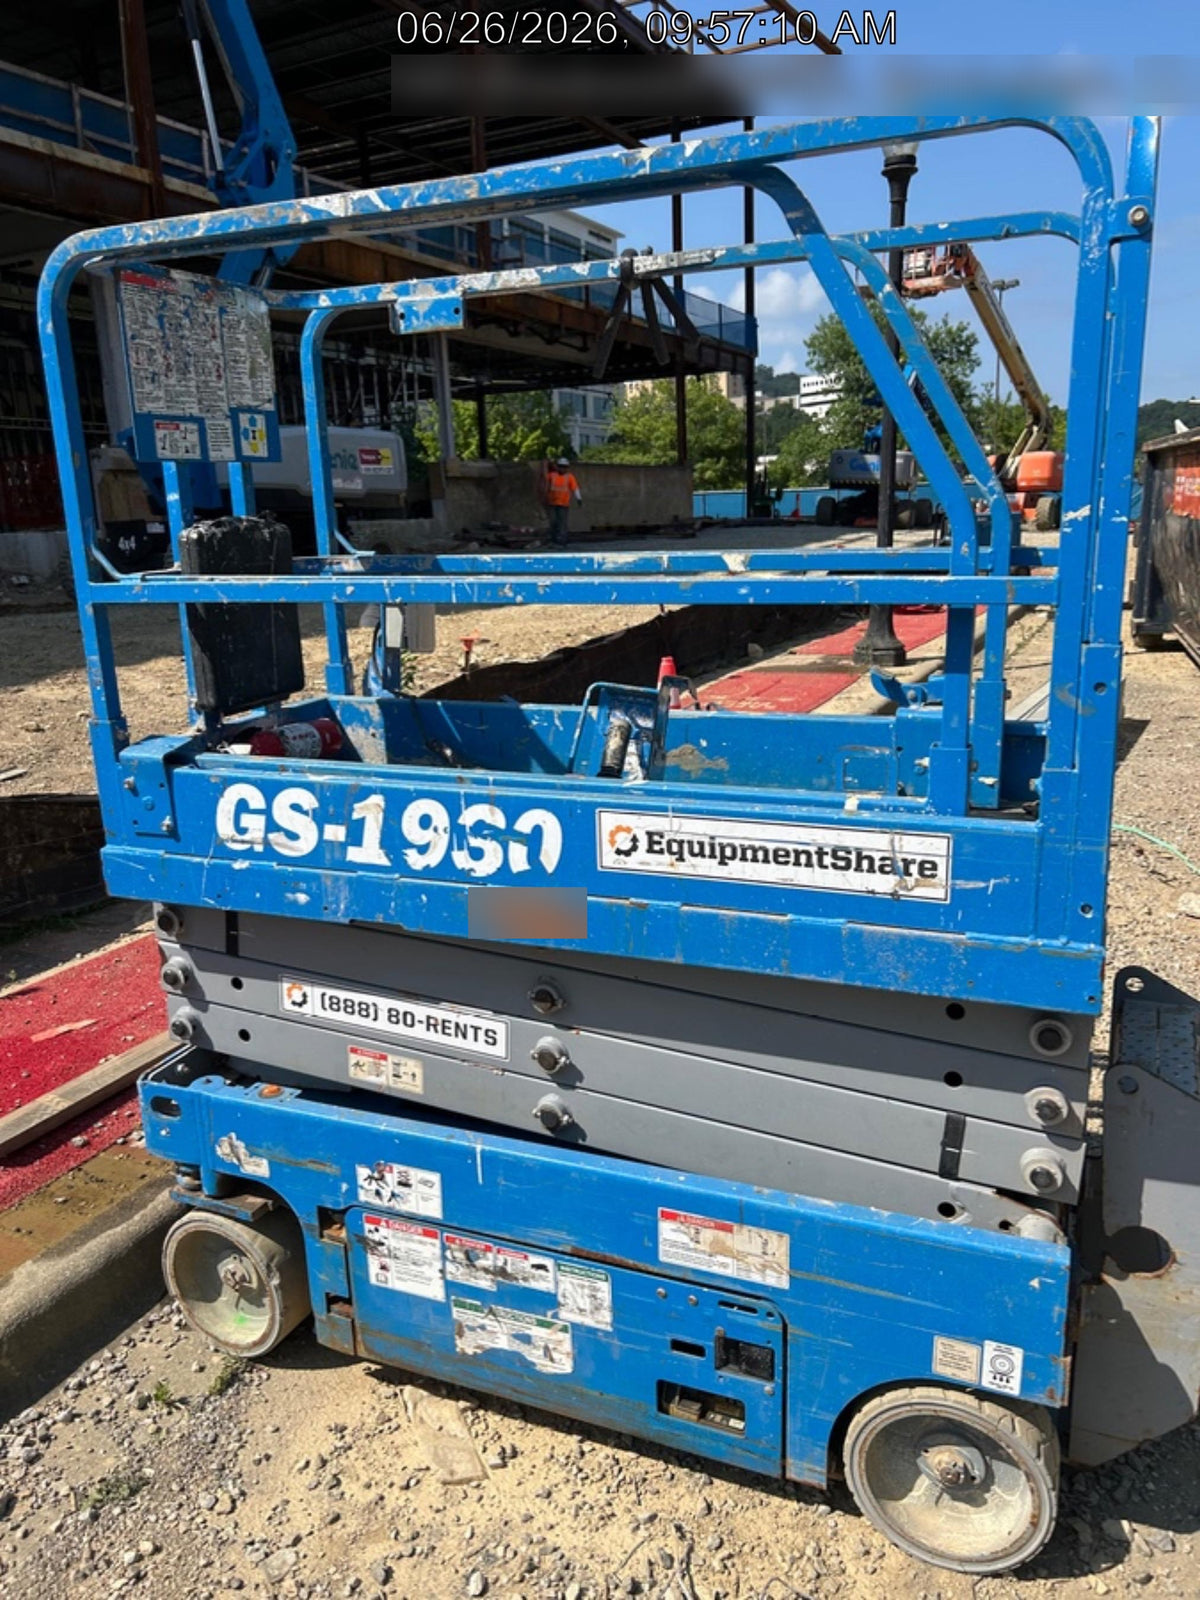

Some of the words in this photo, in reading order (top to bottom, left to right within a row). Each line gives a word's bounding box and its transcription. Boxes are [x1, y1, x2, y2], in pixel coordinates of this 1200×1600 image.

[849, 457, 881, 473] Geni
[118, 535, 136, 551] 4x4
[645, 830, 938, 879] EquipmentShare
[320, 992, 378, 1021] (888)
[387, 1007, 498, 1046] 80-RENTS
